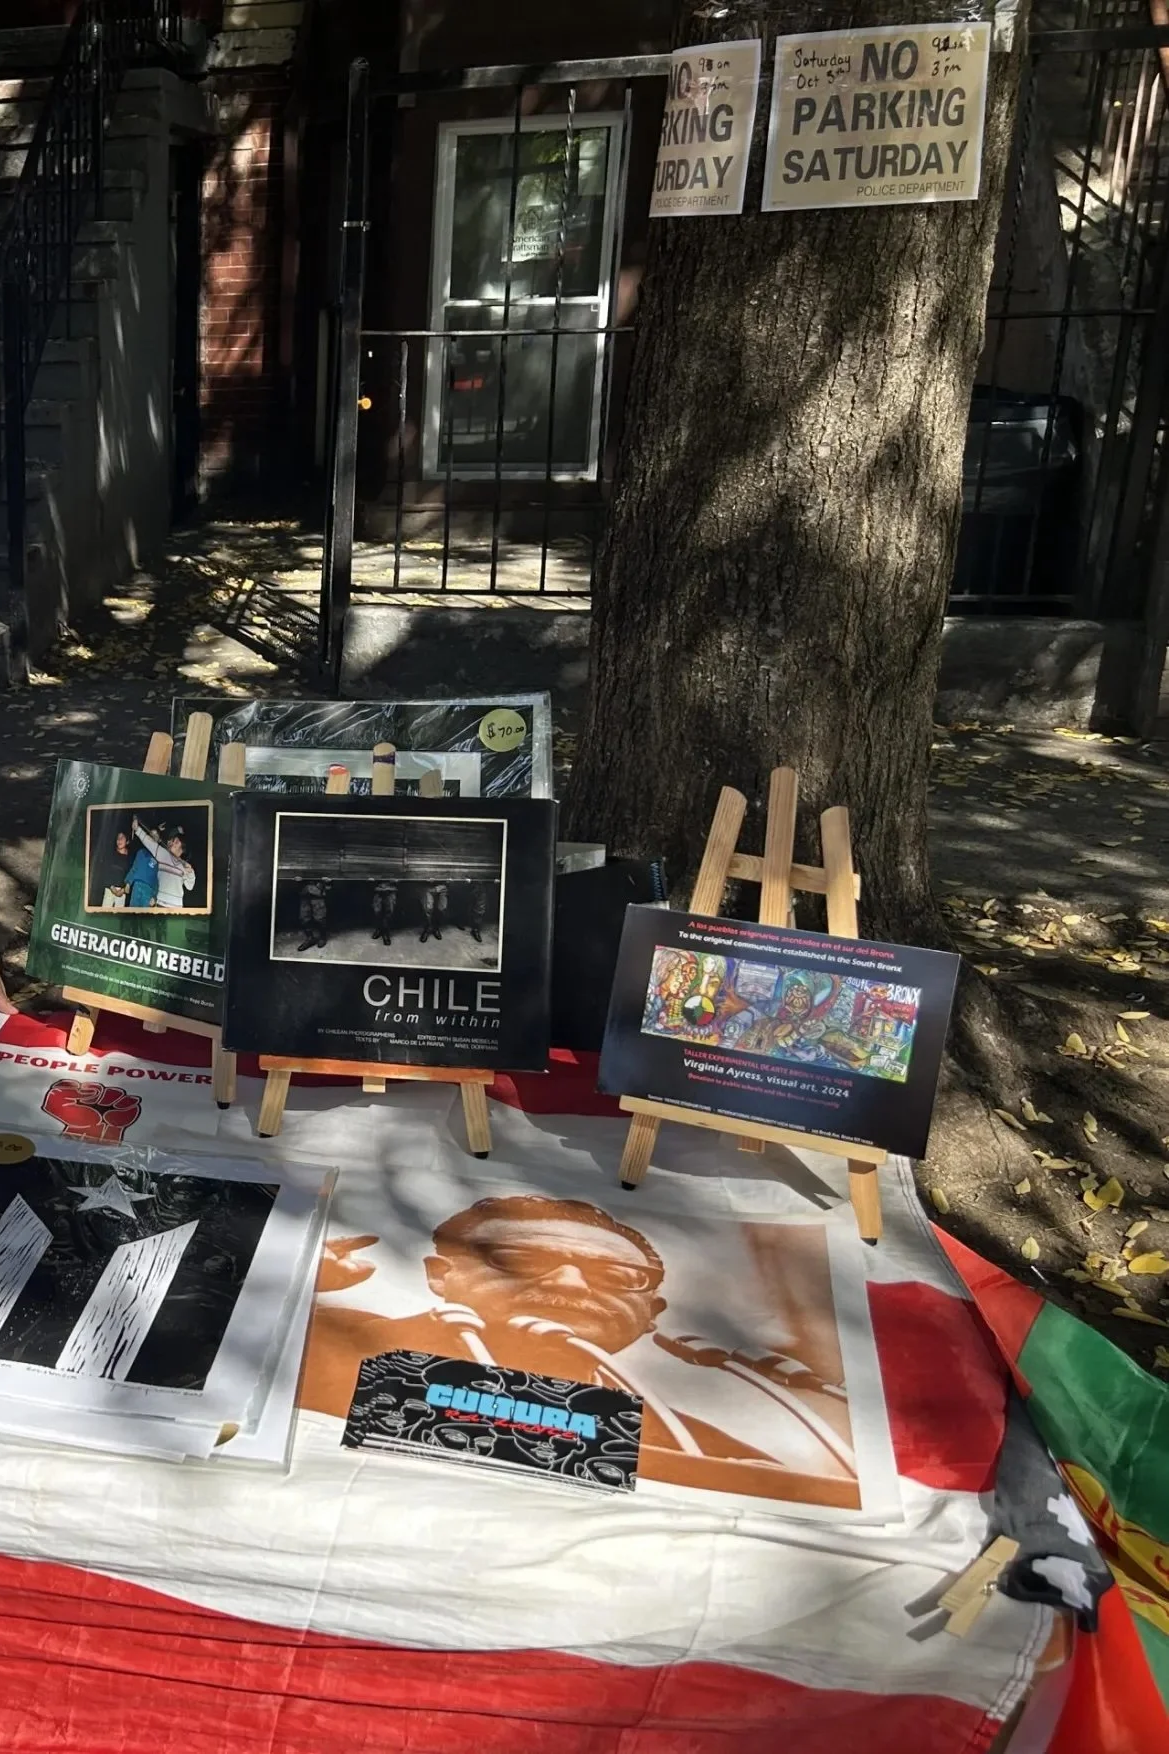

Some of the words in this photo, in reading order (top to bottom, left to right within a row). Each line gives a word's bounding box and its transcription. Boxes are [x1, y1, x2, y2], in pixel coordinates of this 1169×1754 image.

[794, 48, 850, 72] Saturday
[860, 40, 919, 82] NO
[668, 61, 692, 100] NO
[797, 74, 819, 89] Oct
[792, 87, 966, 135] PARKING
[782, 140, 968, 184] SATURDAY
[857, 183, 896, 197] POLICE
[898, 180, 965, 196] DEPARTMENT
[51, 923, 152, 966] GENERACIÓN
[678, 930, 689, 939] To
[689, 932, 703, 941] the
[703, 936, 733, 946] original
[733, 940, 782, 953] communities
[783, 948, 827, 961] established
[827, 954, 836, 962] in
[836, 955, 851, 964] the
[851, 958, 876, 969] South
[877, 962, 903, 973] Bronx
[362, 974, 501, 1013] CHILE
[374, 1010, 420, 1024] from
[435, 1014, 501, 1029] within
[107, 1065, 212, 1085] POWER
[683, 1058, 725, 1074] Virginia
[726, 1066, 764, 1082] Ayress,
[766, 1075, 798, 1089] visual
[821, 1085, 849, 1098] 2024
[425, 1383, 596, 1440] CULTURA
